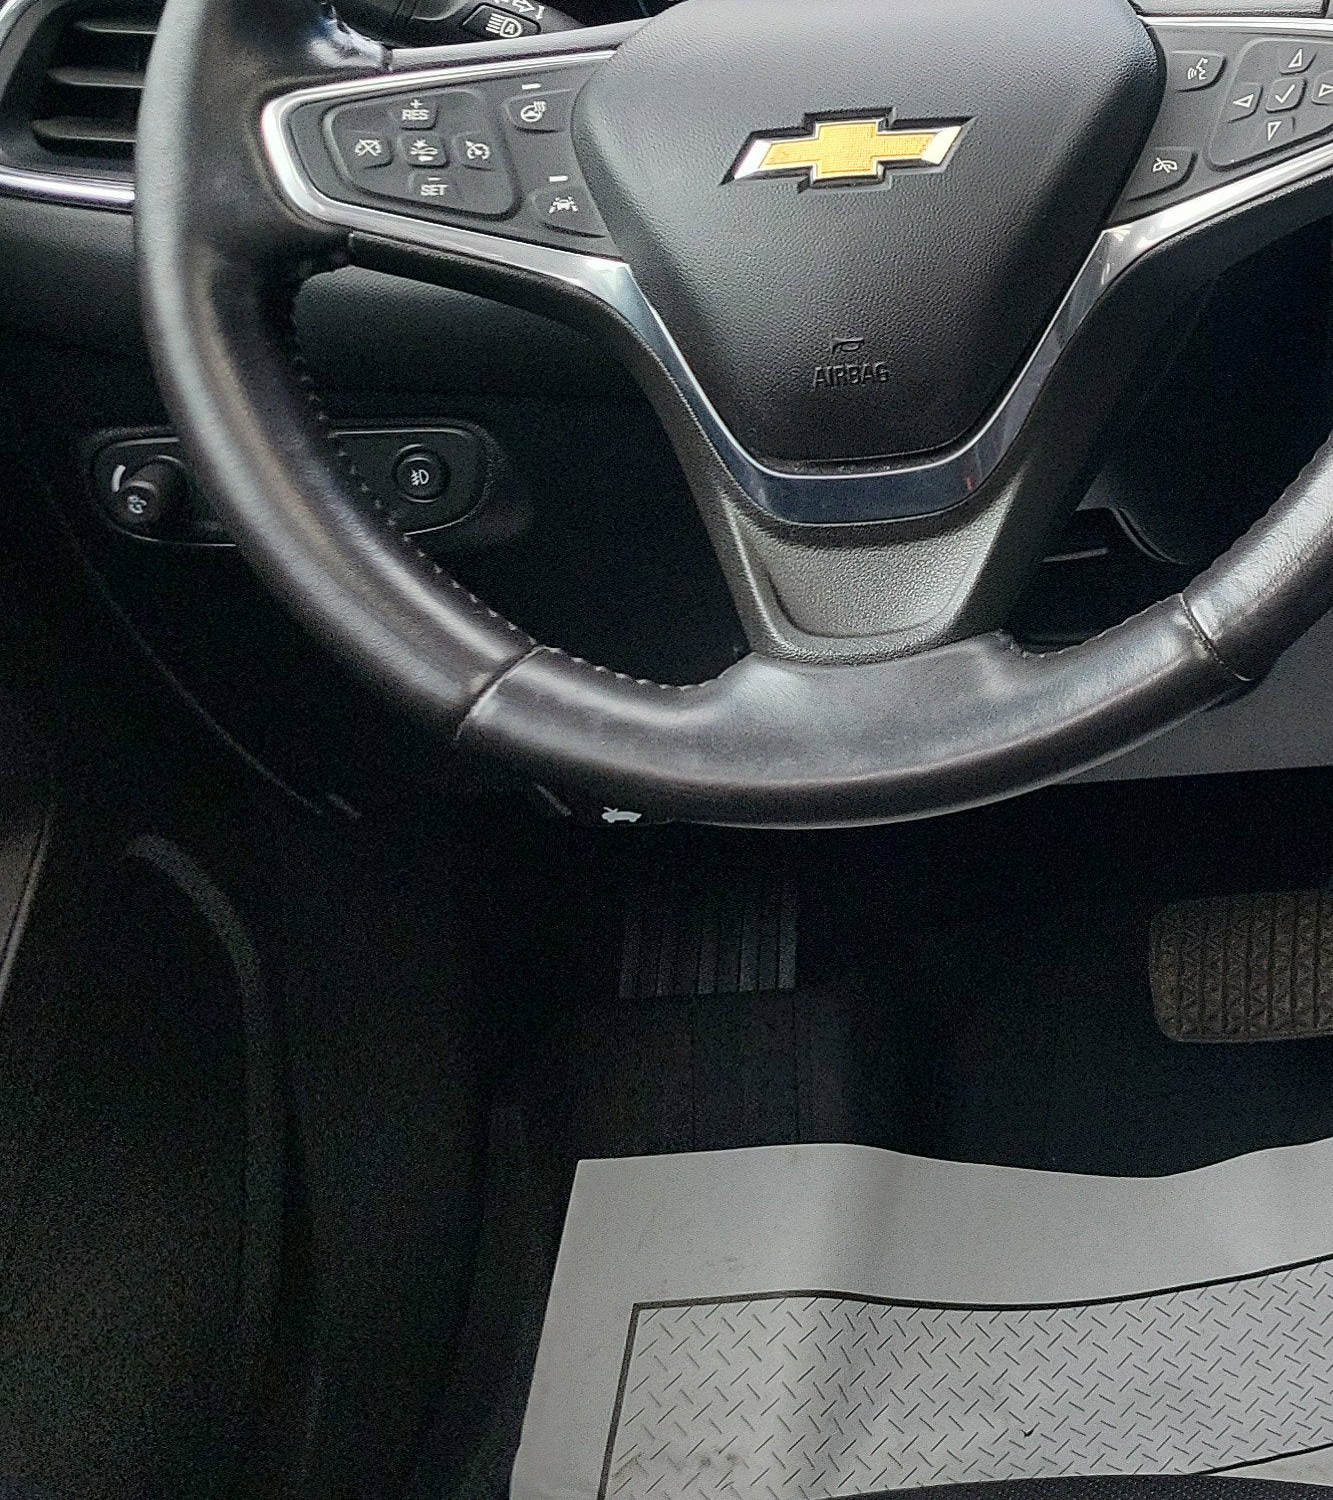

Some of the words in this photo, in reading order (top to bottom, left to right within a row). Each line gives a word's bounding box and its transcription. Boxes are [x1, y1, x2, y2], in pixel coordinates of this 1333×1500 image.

[402, 109, 429, 122] RES
[420, 184, 447, 197] SET
[811, 361, 890, 389] AIRBAG
